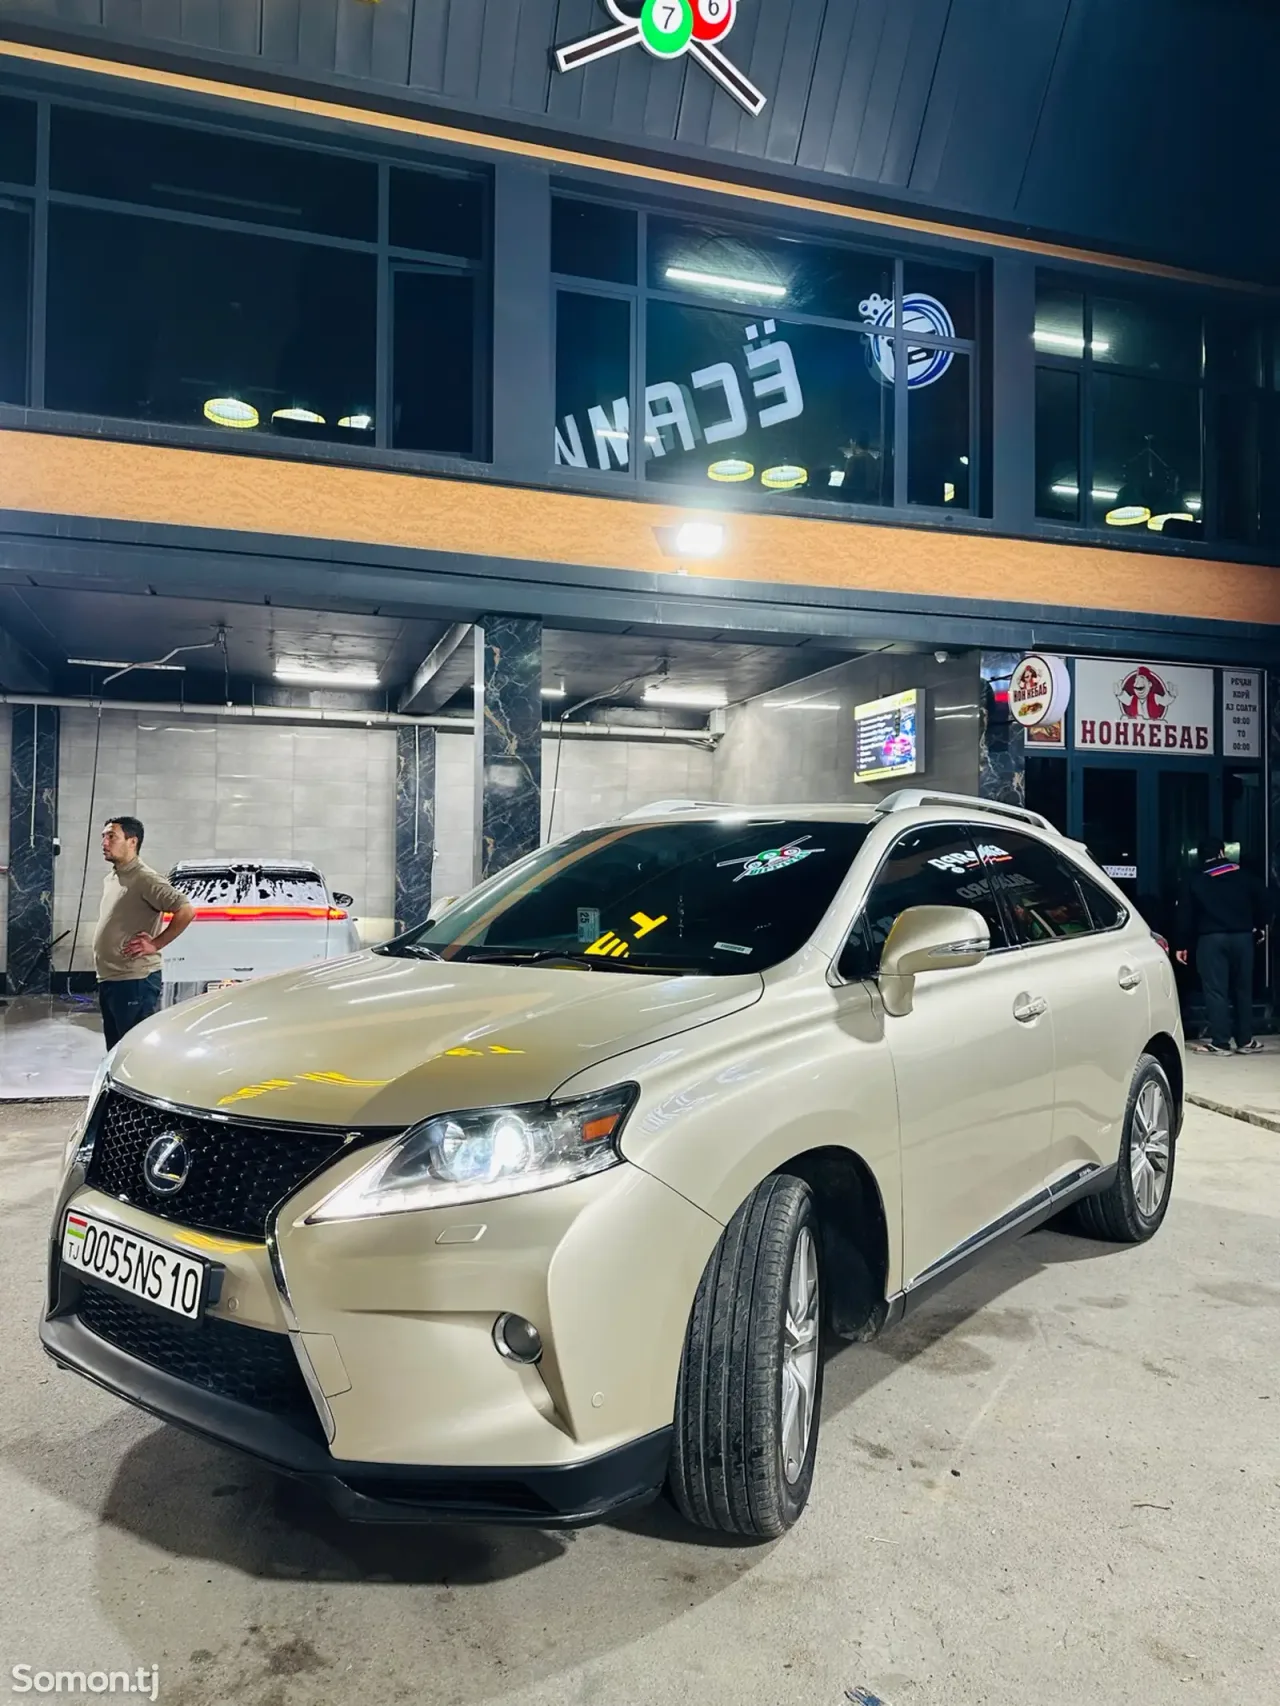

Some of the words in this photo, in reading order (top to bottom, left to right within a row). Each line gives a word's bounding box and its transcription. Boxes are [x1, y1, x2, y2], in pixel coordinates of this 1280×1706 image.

[662, 6, 675, 29] 7
[1081, 720, 1208, 750] НОНКЕБАБ
[69, 1241, 80, 1260] TJ
